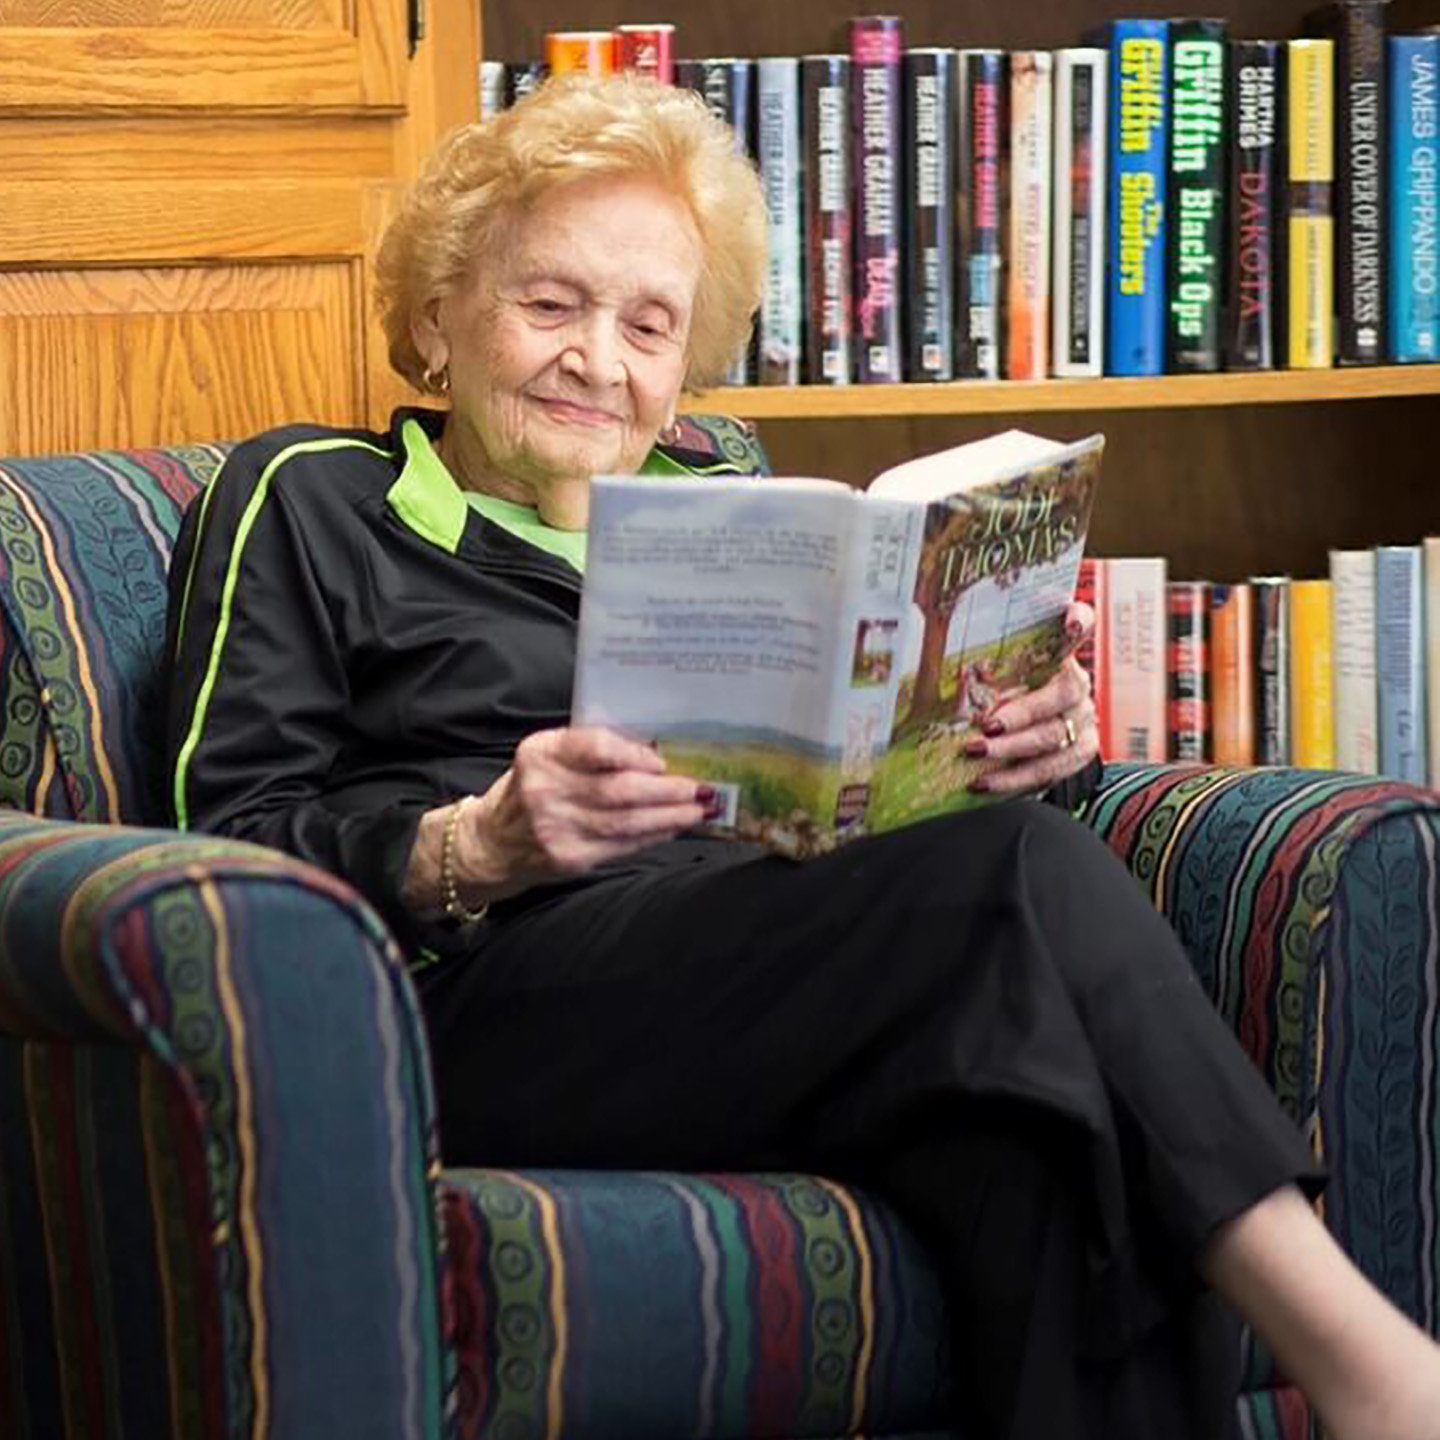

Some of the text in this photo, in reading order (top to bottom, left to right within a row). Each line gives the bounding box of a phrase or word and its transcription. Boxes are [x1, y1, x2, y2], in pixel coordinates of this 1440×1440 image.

[863, 68, 890, 149] HEATHER
[916, 75, 942, 143] HEATHER
[1120, 37, 1163, 153] Griffin
[1172, 40, 1222, 174] Griffin
[1240, 66, 1259, 148] GRIMES
[1258, 66, 1274, 147] MARTHA
[1350, 81, 1379, 142] UNDER
[864, 154, 892, 236] GRAHAM
[1352, 143, 1380, 202] COVER
[1408, 54, 1436, 295] JAMES GRIPPANDO
[1240, 172, 1269, 321] DAKOTA
[1352, 204, 1379, 229] OF
[1172, 187, 1216, 338] Black Ops
[1353, 232, 1380, 322] DARKNESS
[939, 516, 1078, 591] THOMAS
[970, 486, 1058, 541] JODI
